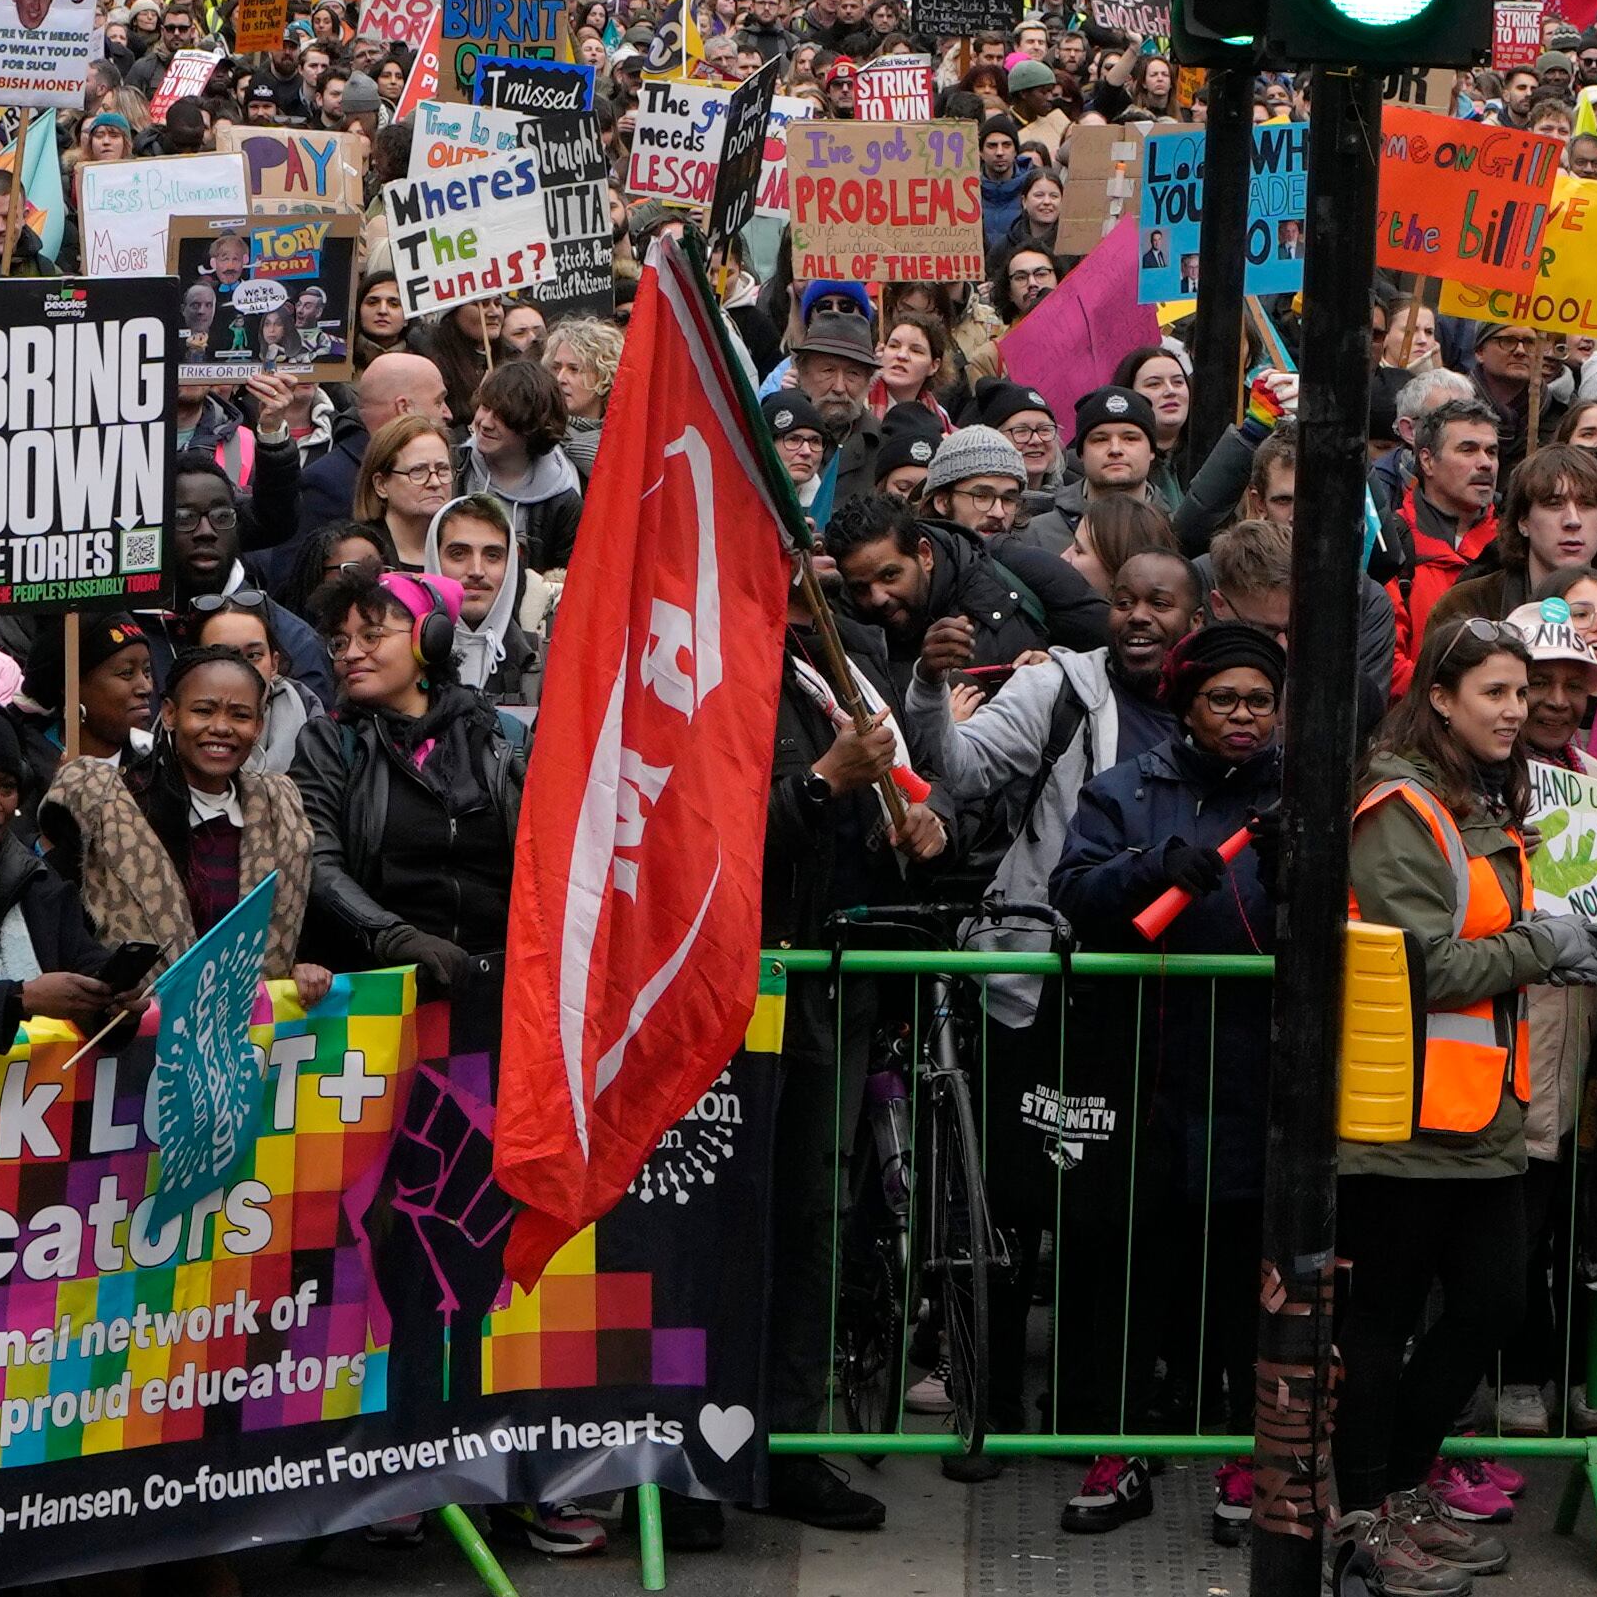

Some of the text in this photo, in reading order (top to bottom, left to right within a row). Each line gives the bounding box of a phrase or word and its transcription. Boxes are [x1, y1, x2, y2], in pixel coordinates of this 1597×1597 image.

[18, 28, 47, 41] VERY
[49, 31, 89, 42] HEROIC
[1496, 12, 1540, 27] STRIKE
[1496, 27, 1540, 44] TO WIN
[2, 59, 56, 71] FOR SUCH
[8, 44, 45, 56] WHAT
[47, 46, 68, 56] YOU
[70, 47, 88, 57] DO
[33, 79, 85, 92] MONEY
[644, 83, 690, 116] The
[857, 69, 929, 99] STRIKE
[858, 96, 931, 121] TO WIN
[521, 116, 602, 181] Straight
[640, 122, 704, 152] needs
[805, 127, 964, 176] I've got 99
[241, 136, 337, 196] PAY
[390, 155, 537, 226] Where's
[795, 176, 981, 226] PROBLEMS
[255, 222, 332, 259] TORY
[397, 227, 478, 271] The
[406, 242, 547, 311] Funds?
[803, 255, 981, 280] ALL OF THEM!!!
[44, 299, 87, 311] peoples
[8, 530, 114, 584] TORIES
[12, 582, 67, 604] PEOPLE'S
[67, 576, 125, 600] ASSEMBLY
[126, 573, 161, 594] TODAY
[1534, 623, 1585, 652] NHS
[1020, 1092, 1116, 1131] STRENGTH
[79, 1290, 262, 1362] network
[269, 1279, 319, 1330] of
[0, 1373, 133, 1448] proud
[140, 1346, 368, 1418] educators
[142, 1448, 327, 1509] Co-founder:
[328, 1432, 451, 1476] Forever
[452, 1428, 485, 1461] in
[490, 1421, 551, 1455] our
[551, 1411, 684, 1451] hearts
